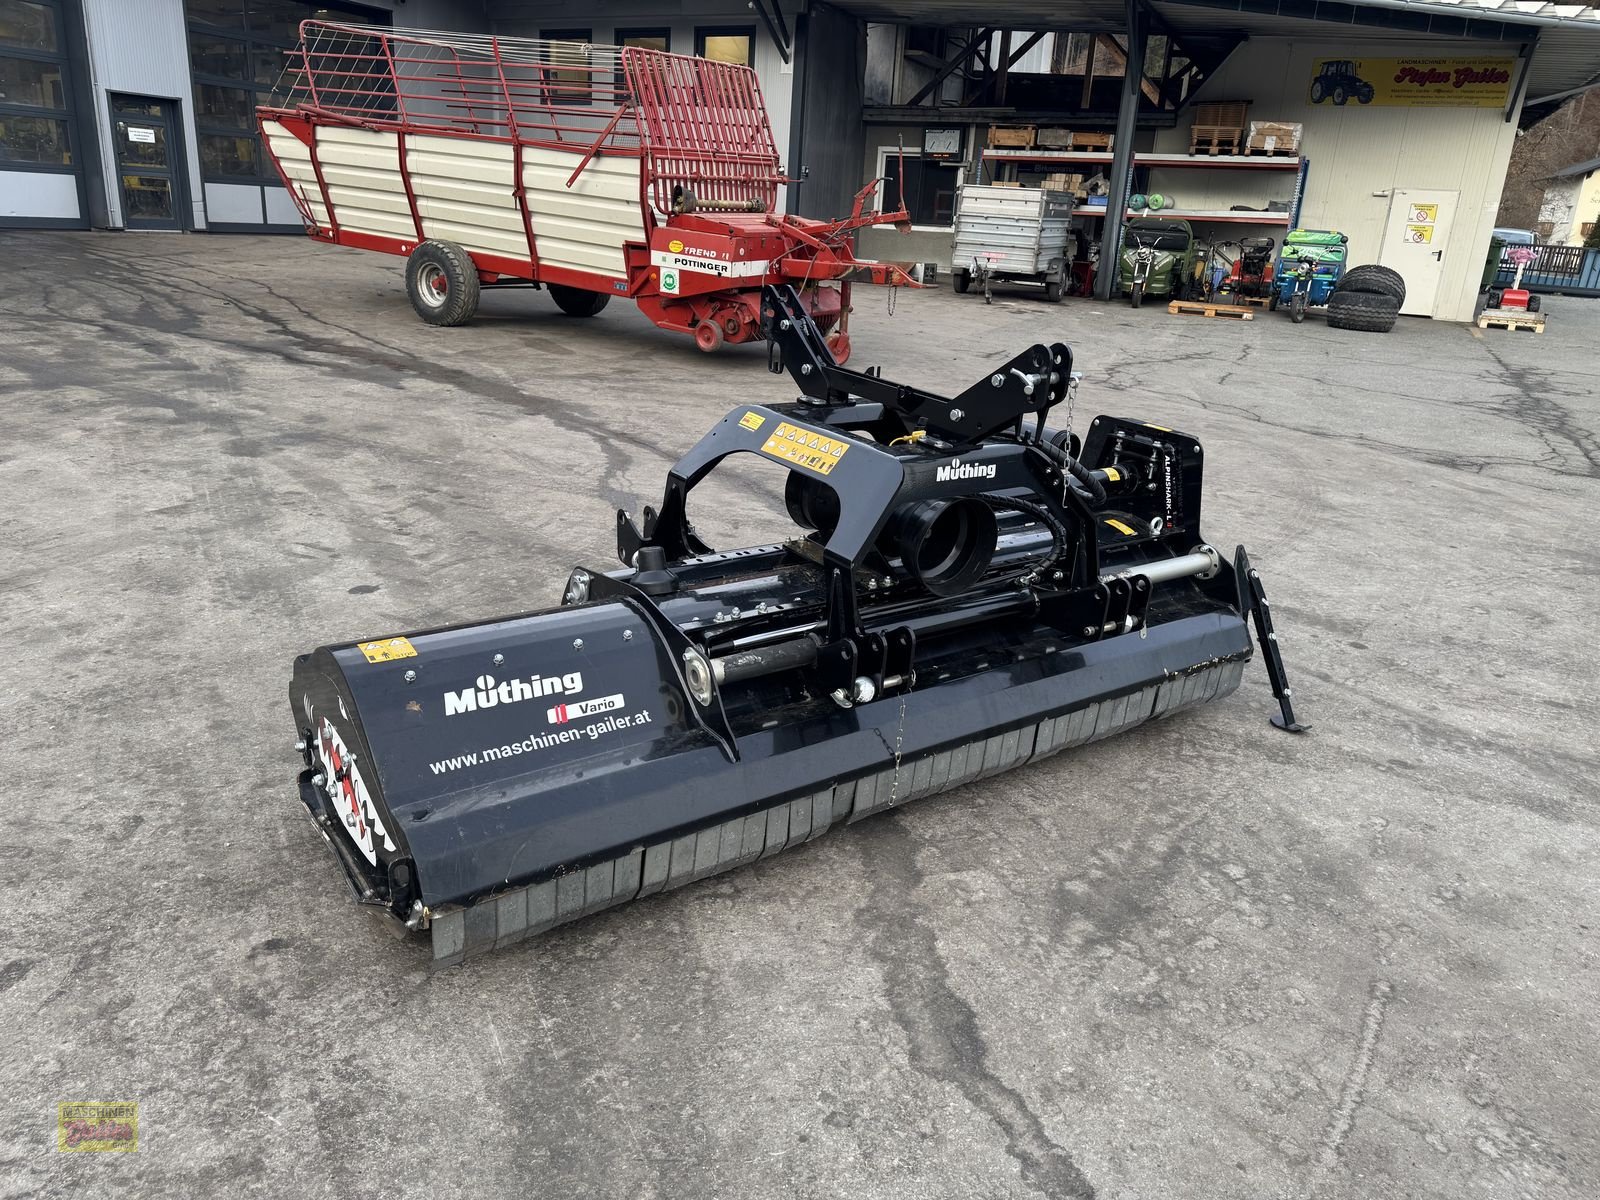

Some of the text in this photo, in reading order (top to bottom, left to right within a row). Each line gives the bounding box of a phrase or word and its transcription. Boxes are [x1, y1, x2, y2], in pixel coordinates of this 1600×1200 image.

[1394, 66, 1510, 88] Stefan Gailer
[684, 246, 717, 257] TREND
[936, 458, 997, 482] Müthing
[443, 671, 584, 716] Müthing
[578, 699, 616, 715] Vario
[429, 709, 653, 775] www.maschinen-gailer.at
